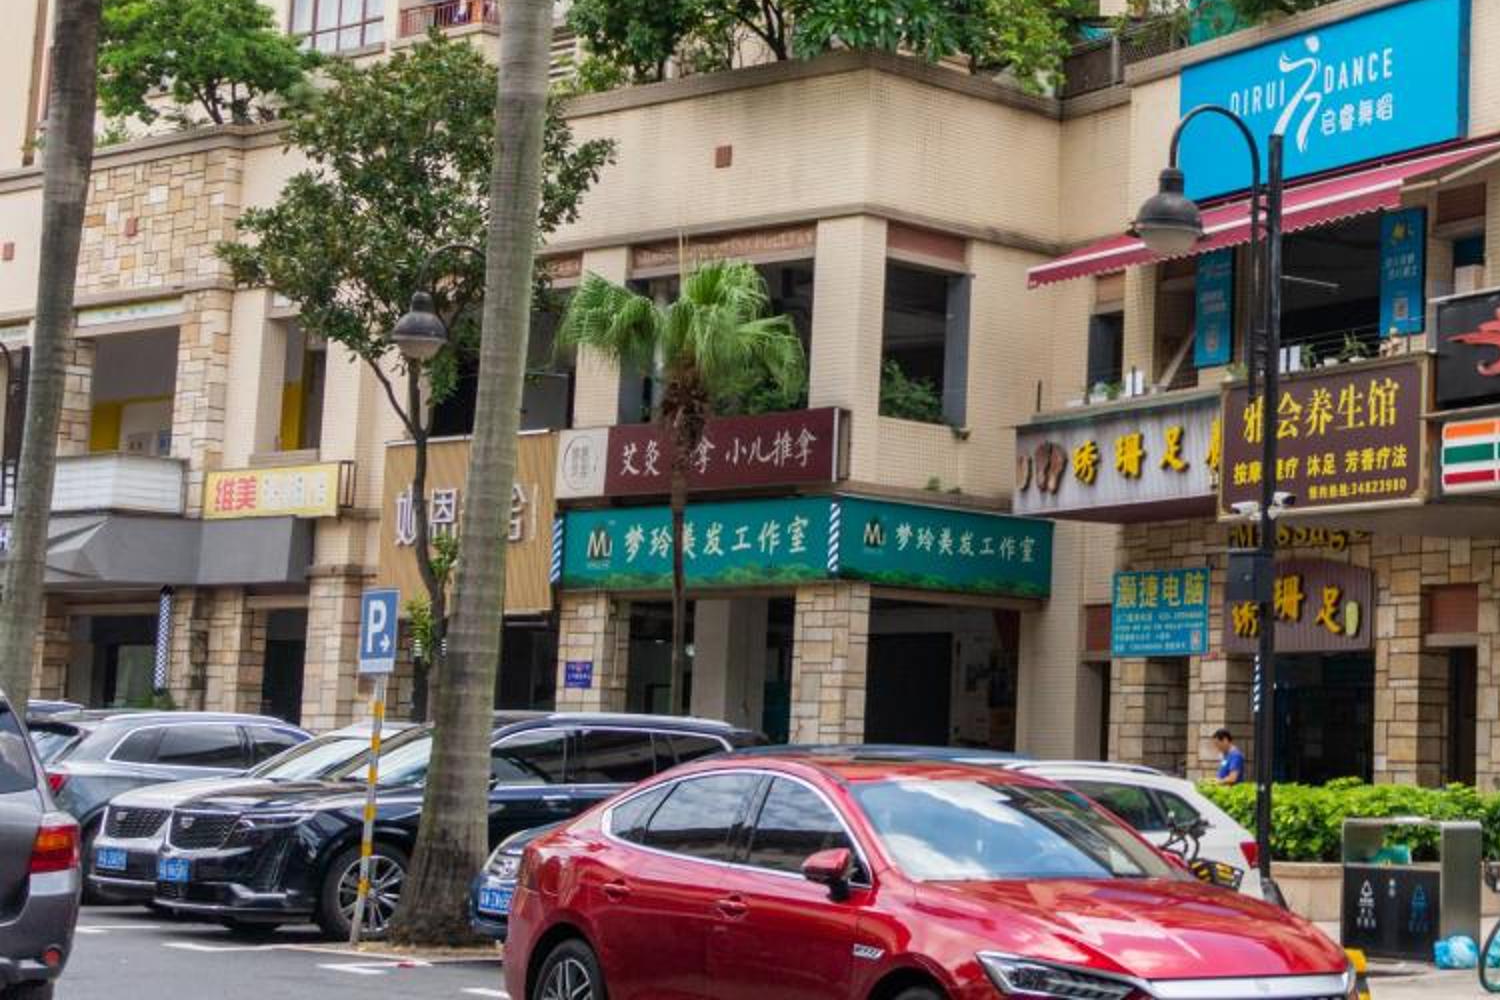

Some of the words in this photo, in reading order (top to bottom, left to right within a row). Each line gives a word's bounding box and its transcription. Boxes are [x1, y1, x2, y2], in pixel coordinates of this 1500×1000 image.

[1322, 47, 1393, 94] DANCE
[620, 440, 661, 477] 艾灸
[725, 428, 817, 468] 小儿推拿
[366, 600, 387, 653] P
